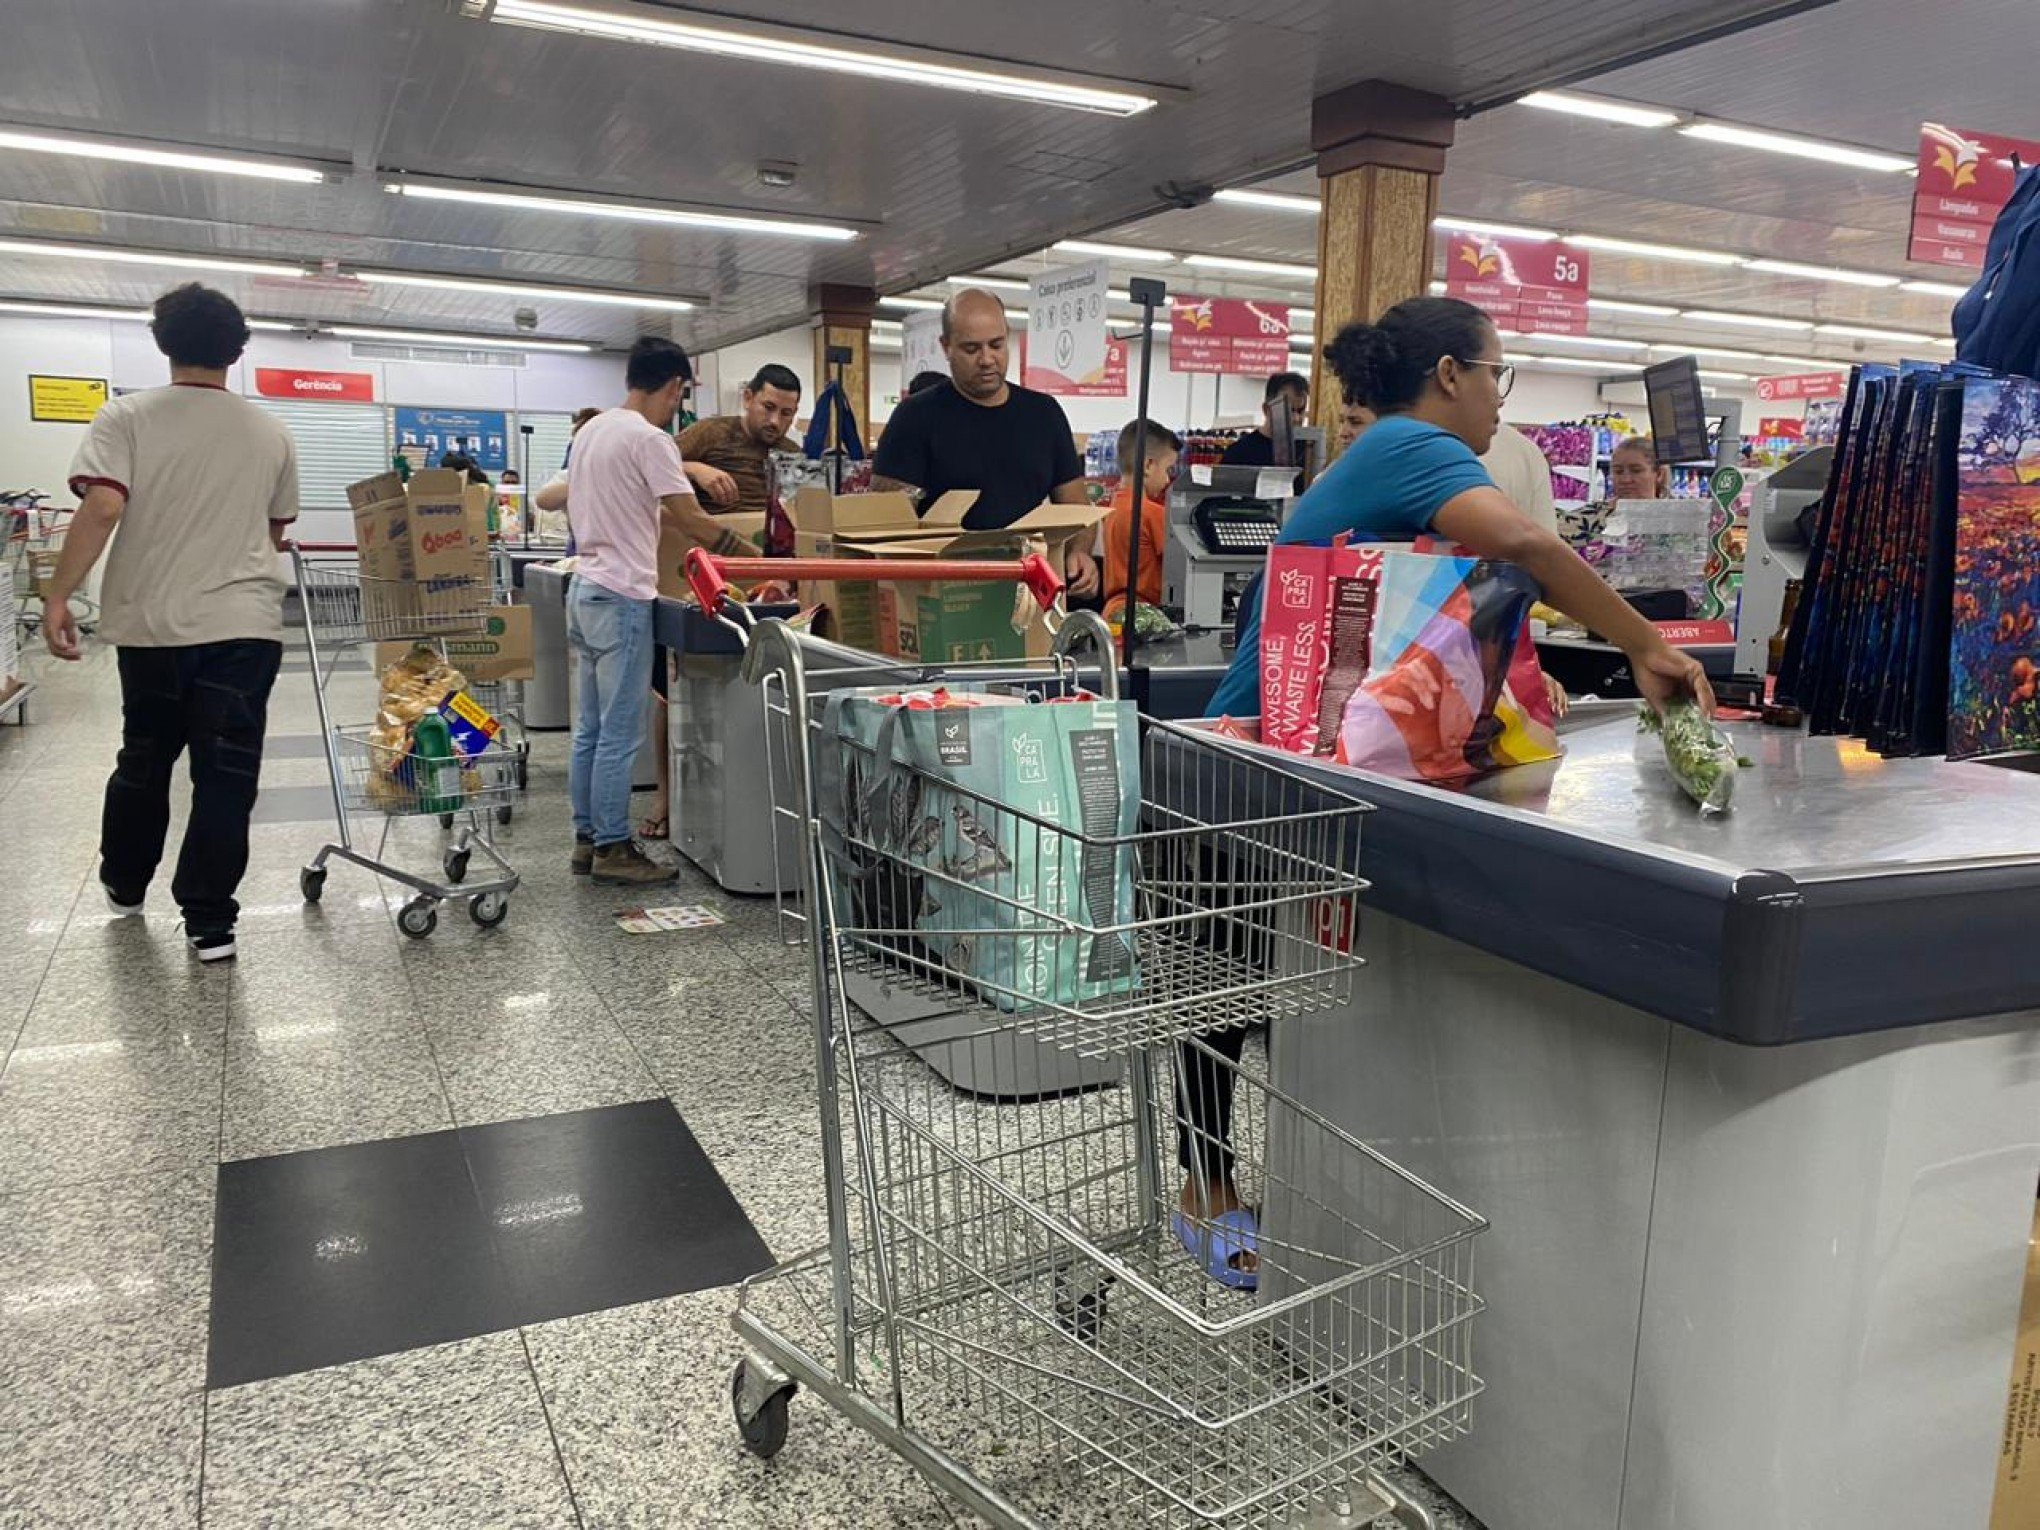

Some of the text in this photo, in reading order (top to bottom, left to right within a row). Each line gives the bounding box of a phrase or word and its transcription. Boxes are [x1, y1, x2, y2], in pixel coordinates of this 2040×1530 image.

[1555, 255, 1579, 282] 5a
[293, 378, 343, 392] Gerência
[1265, 636, 1288, 740] AWESOME,
[1281, 667, 1308, 733] WASTE
[1042, 866, 1067, 951] GEEN
